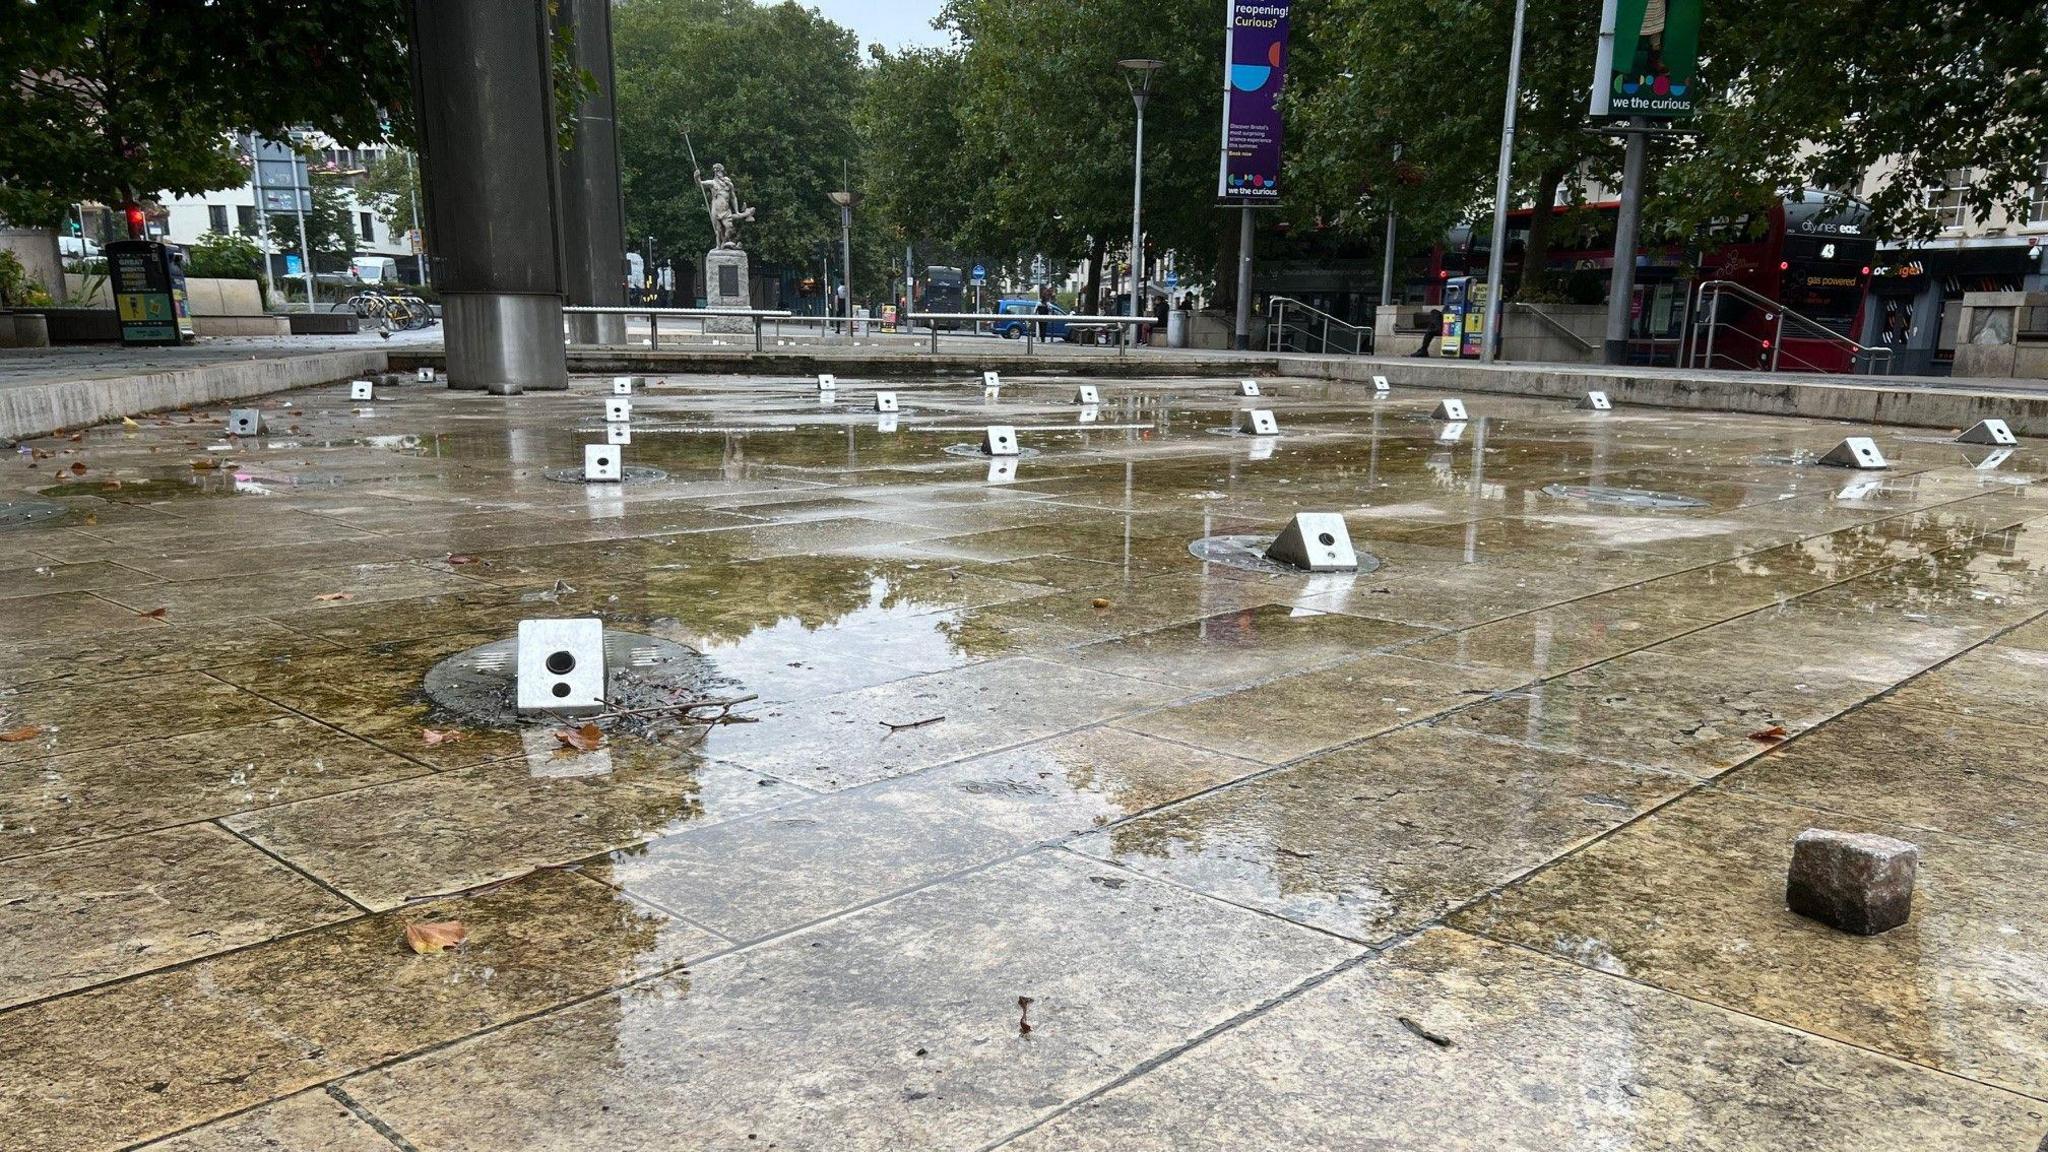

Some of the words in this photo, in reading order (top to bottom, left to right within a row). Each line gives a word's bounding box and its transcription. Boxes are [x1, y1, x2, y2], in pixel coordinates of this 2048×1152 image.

[1236, 5, 1289, 18] reopening!
[1235, 16, 1277, 28] Curious?
[1613, 98, 1629, 108] we
[1631, 97, 1649, 109] the
[1651, 98, 1691, 110] curious
[1239, 187, 1251, 195] the
[1252, 188, 1278, 196] curious
[1801, 219, 1837, 234] citynes
[1807, 276, 1821, 286] gas
[1822, 276, 1857, 287] powered
